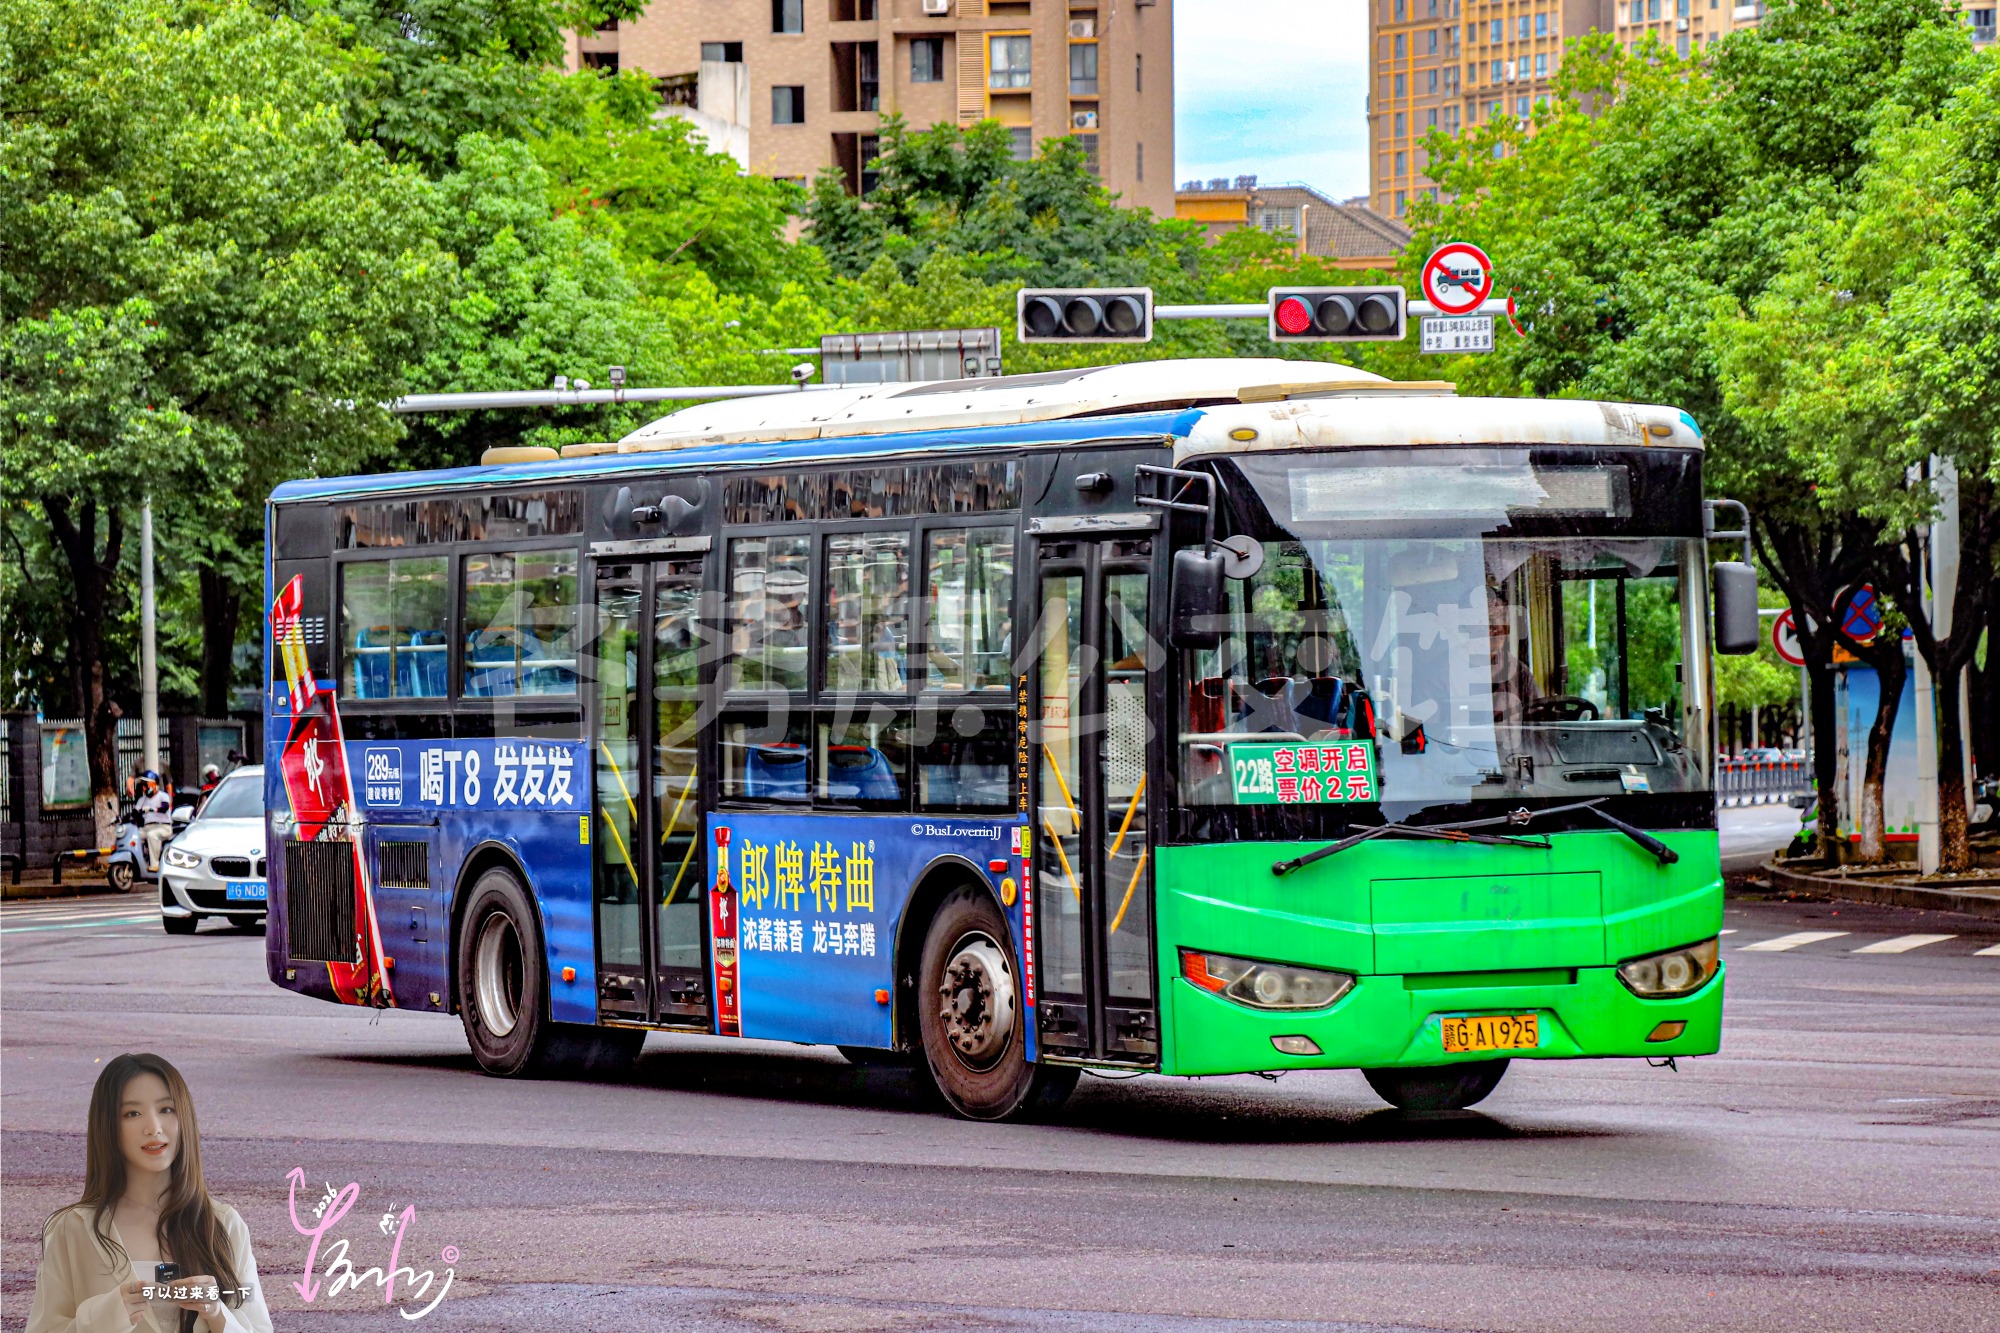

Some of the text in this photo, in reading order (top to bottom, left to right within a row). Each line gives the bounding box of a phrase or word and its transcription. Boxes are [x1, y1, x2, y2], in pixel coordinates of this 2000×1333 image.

[1018, 674, 1029, 811] 严禁携带危险品上车
[1273, 744, 1368, 774] 空调开启
[367, 786, 400, 801] 建议零售价
[419, 744, 574, 806] 喝T8 发发发
[1235, 758, 1275, 795] 22路
[1276, 775, 1372, 804] 票价2元
[742, 917, 876, 957] 浓酱兼香 龙马奔腾
